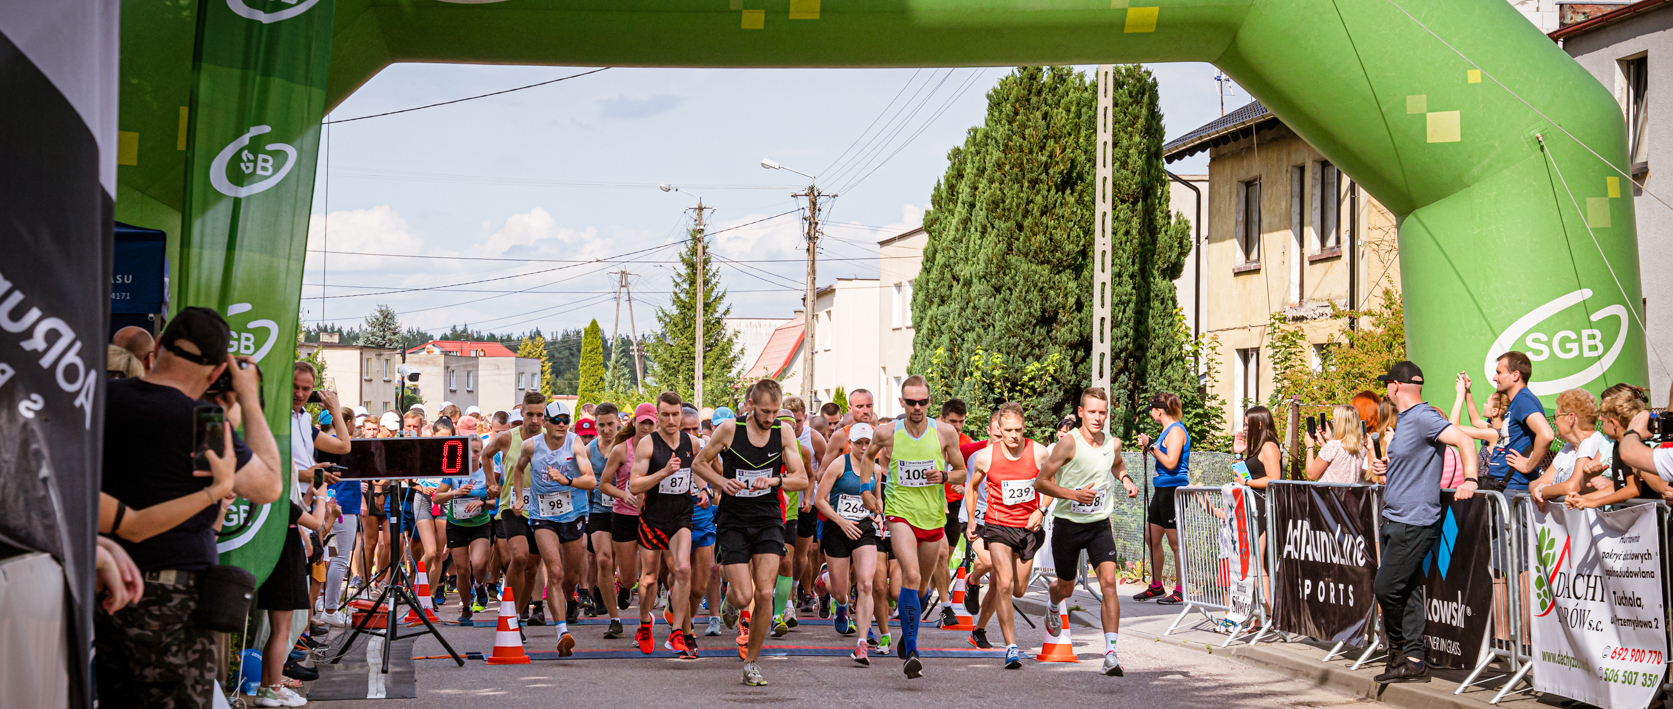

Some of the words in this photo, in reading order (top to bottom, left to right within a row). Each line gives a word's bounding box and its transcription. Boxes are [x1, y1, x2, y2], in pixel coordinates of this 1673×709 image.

[1525, 328, 1604, 361] SGB
[441, 440, 463, 473] 0
[670, 477, 684, 488] 87
[1008, 487, 1031, 499] 239
[548, 498, 563, 511] 98
[843, 502, 865, 514] 264
[1555, 571, 1605, 602] DACHY
[1653, 617, 1659, 629] 2
[1610, 646, 1629, 661] 692
[1629, 648, 1646, 663] 900
[1646, 649, 1663, 665] 770
[1603, 667, 1620, 683] 506
[1621, 670, 1640, 686] 507
[1641, 672, 1659, 688] 350
